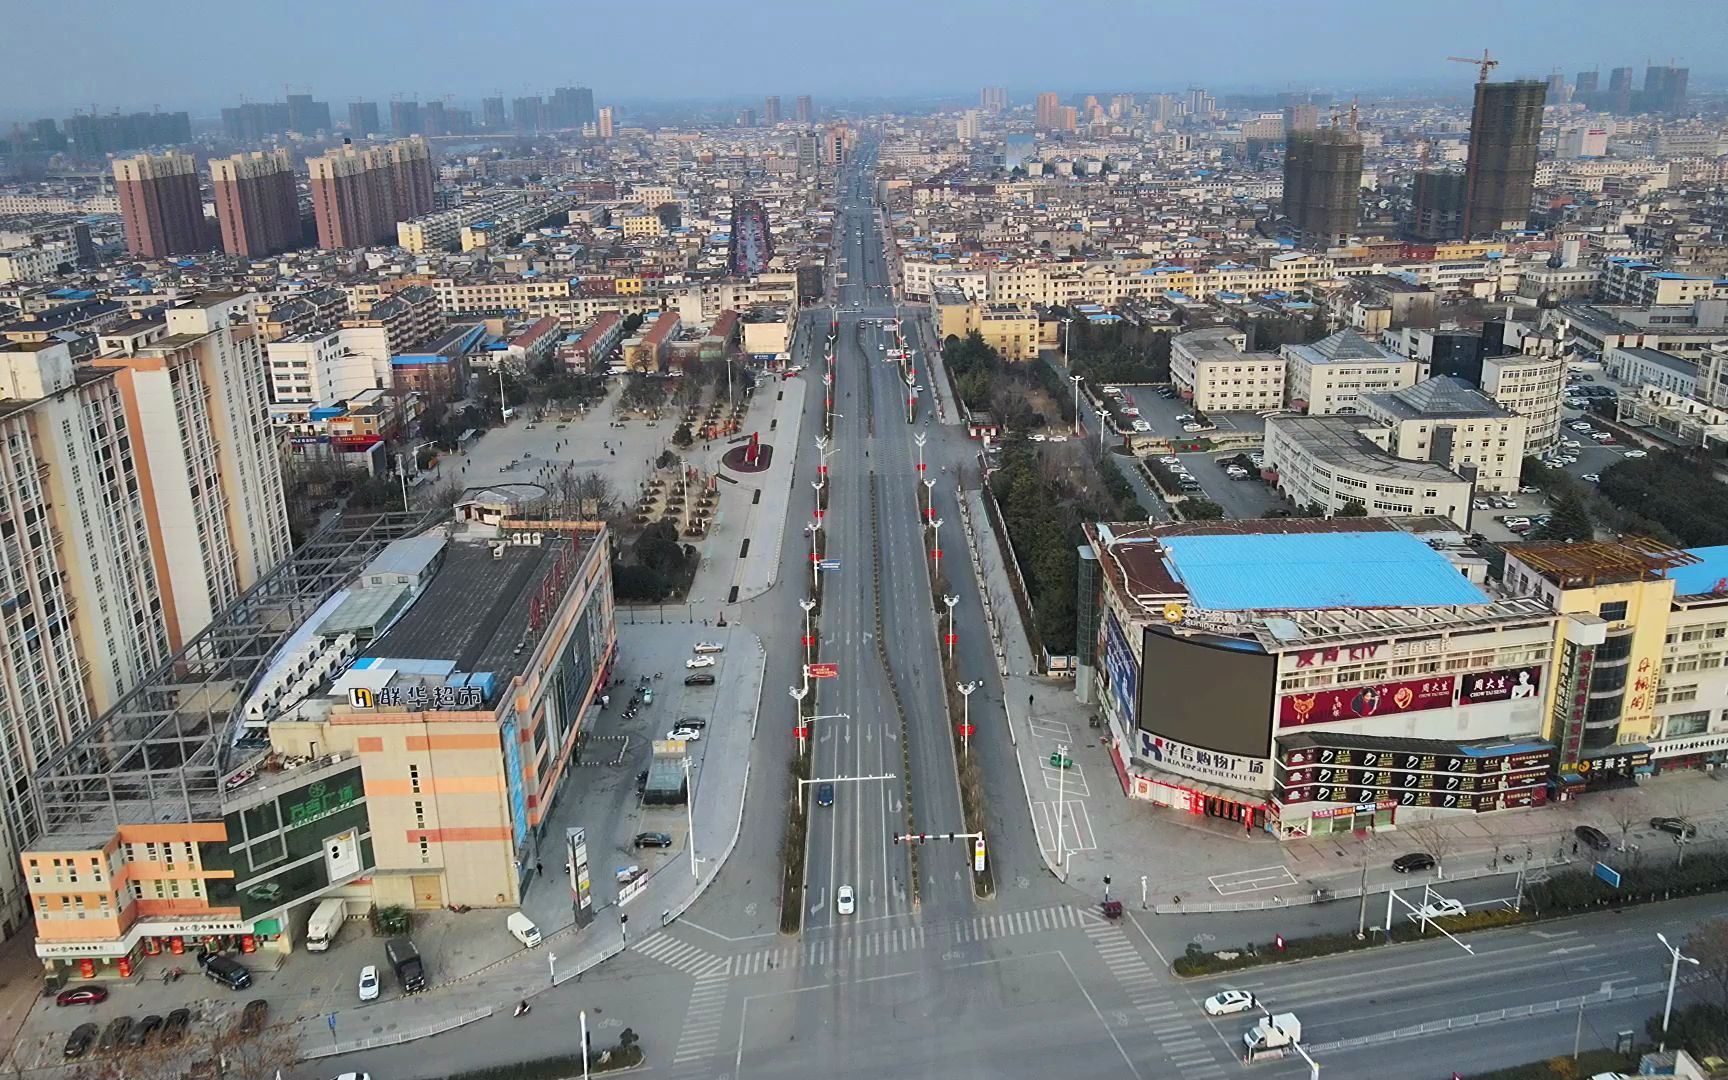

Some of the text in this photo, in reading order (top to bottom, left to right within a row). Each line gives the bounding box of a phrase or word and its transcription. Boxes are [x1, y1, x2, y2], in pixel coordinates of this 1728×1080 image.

[1421, 681, 1449, 693] 周大生
[1473, 675, 1505, 691] 周大生
[379, 685, 483, 708] 联华超市
[1164, 741, 1264, 774] 华信购物广场
[1591, 756, 1628, 771] 华莱士
